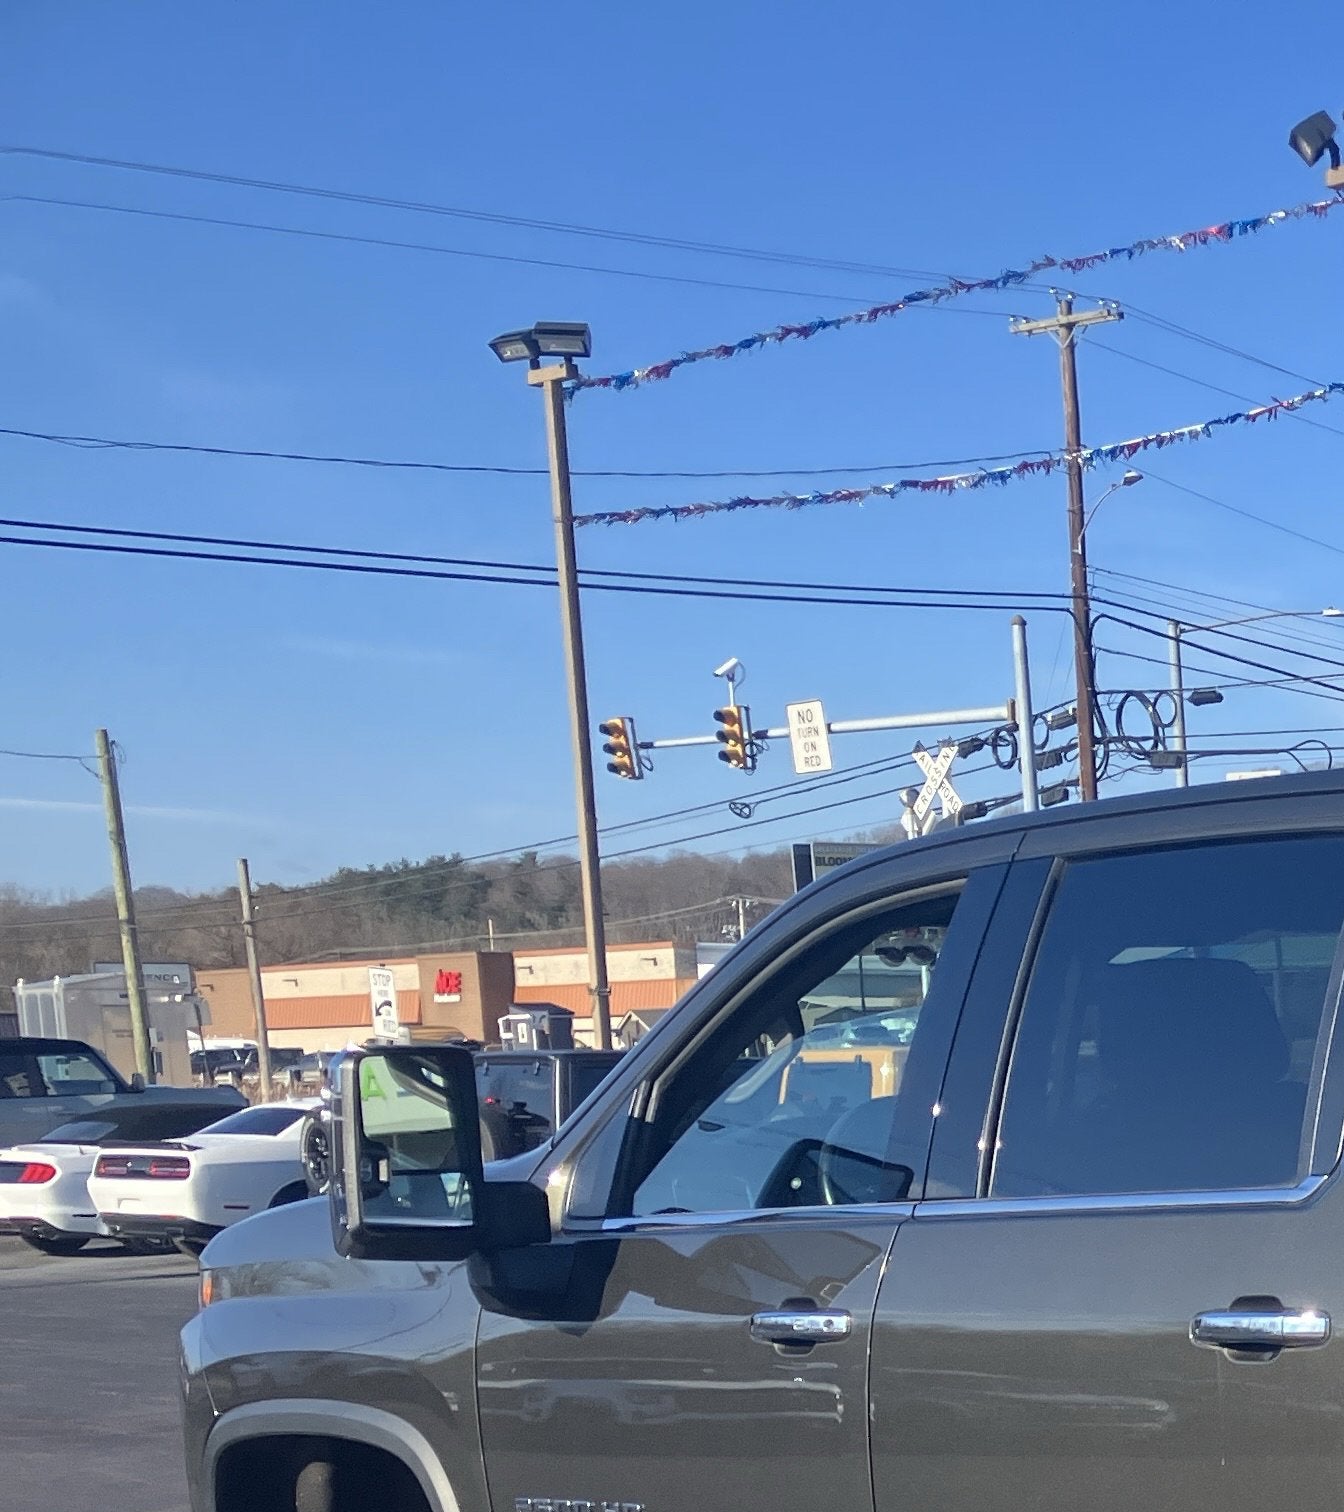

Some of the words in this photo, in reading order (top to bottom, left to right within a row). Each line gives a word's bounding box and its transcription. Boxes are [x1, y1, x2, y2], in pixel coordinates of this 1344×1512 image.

[797, 709, 813, 724] NO
[798, 726, 819, 739] TURN
[804, 741, 817, 753] ON
[804, 756, 821, 767] RED
[373, 973, 391, 986] STOP
